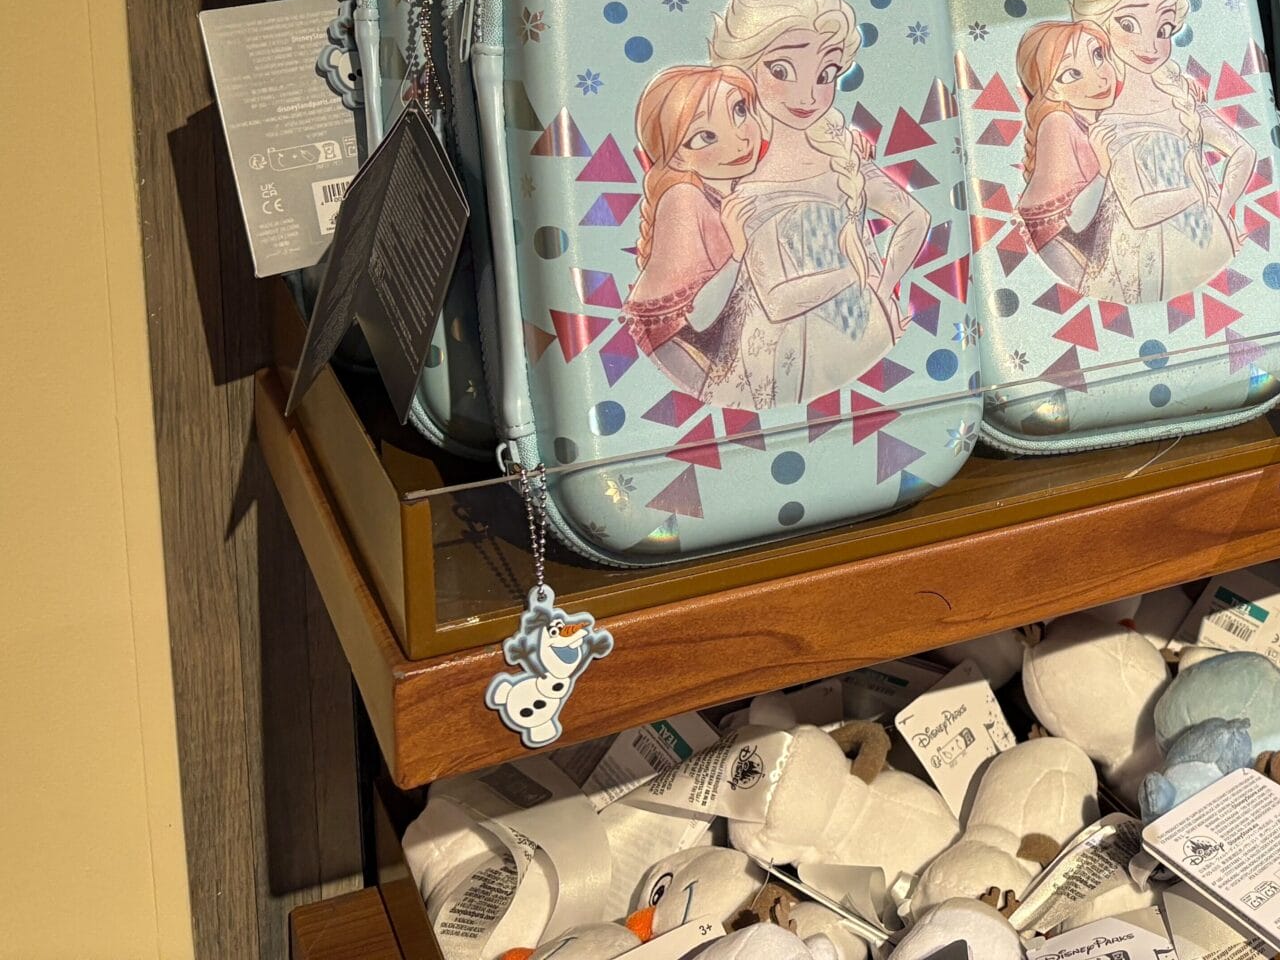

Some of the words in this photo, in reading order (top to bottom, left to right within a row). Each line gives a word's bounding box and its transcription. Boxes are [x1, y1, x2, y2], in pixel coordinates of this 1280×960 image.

[262, 199, 284, 214] CE
[659, 723, 679, 750] TEAL
[912, 721, 949, 748] Disney
[727, 744, 757, 791] Disney
[1183, 842, 1225, 866] Disney
[699, 923, 713, 936] 3+
[1093, 933, 1135, 947] PARKS
